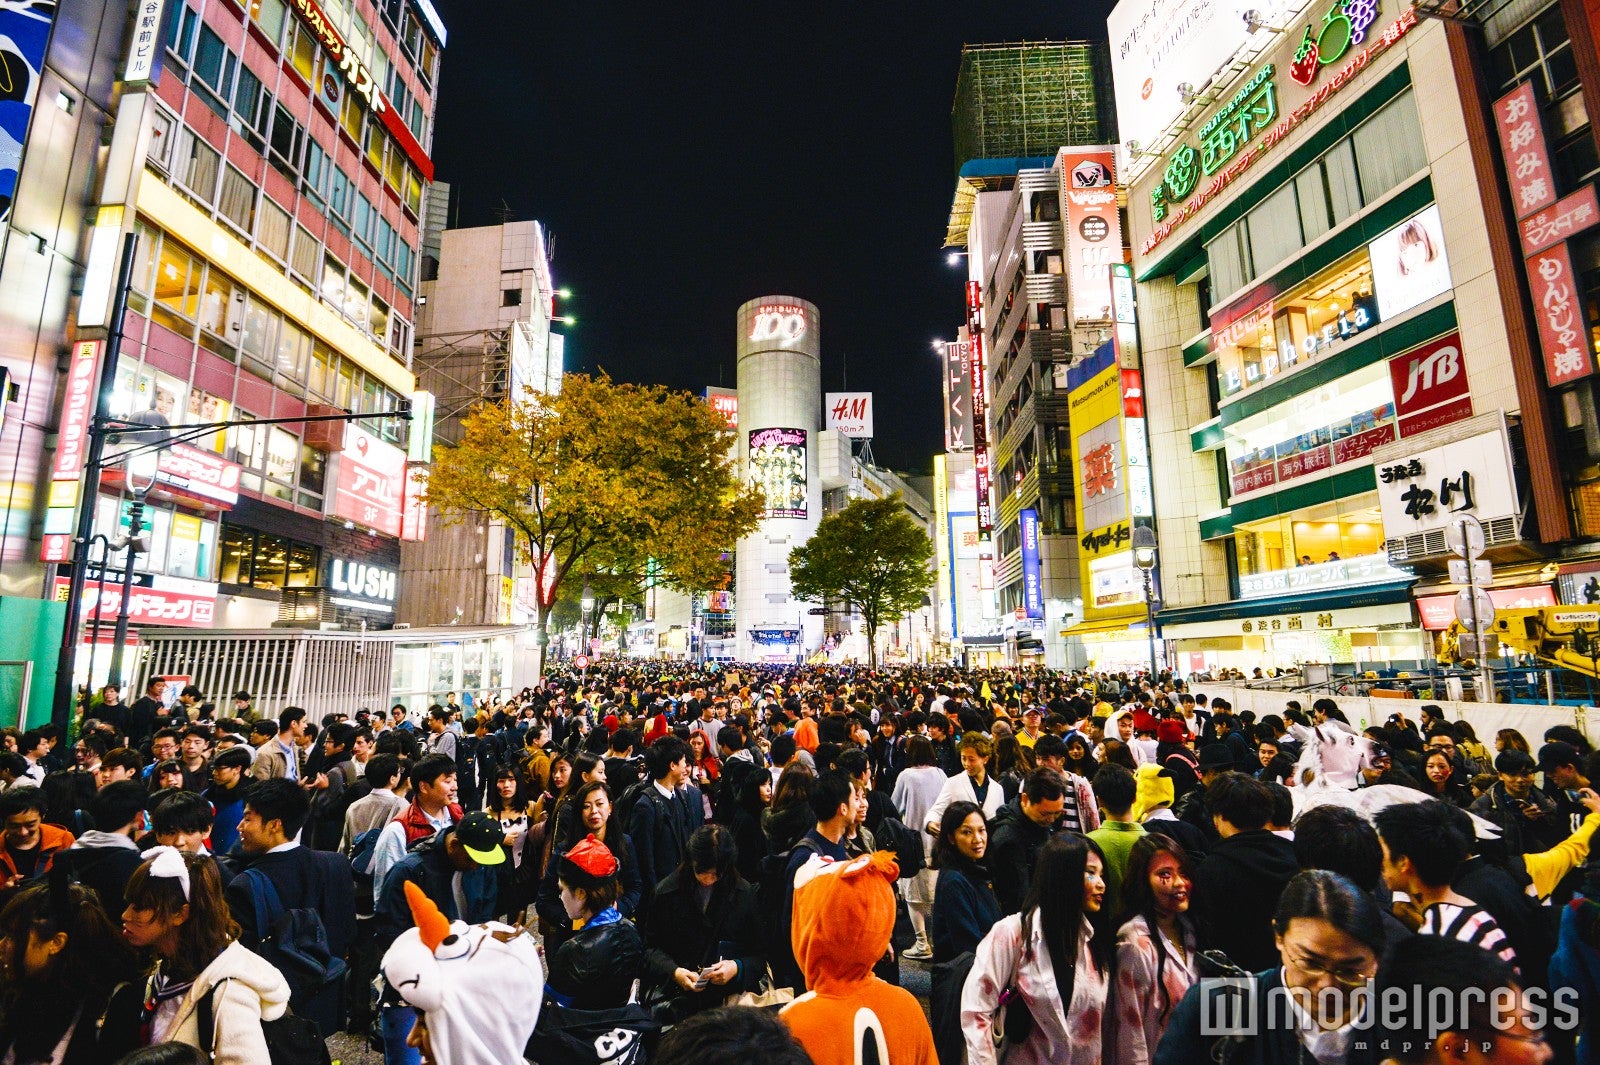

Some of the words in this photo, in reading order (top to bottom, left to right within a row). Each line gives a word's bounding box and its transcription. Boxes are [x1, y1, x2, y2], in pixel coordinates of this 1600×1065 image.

[133, 2, 158, 72] 谷駅前ビル
[340, 47, 386, 112] ガスト
[1198, 107, 1227, 138] FRUITS
[1235, 63, 1272, 102] PARLOR
[1201, 81, 1275, 177] 西村
[1505, 95, 1548, 209] お好み焼
[1152, 184, 1166, 223] 渋谷
[1524, 213, 1547, 231] 渋谷
[760, 306, 804, 315] SHIBUYA
[1538, 257, 1583, 377] もんじゃ焼
[749, 312, 806, 348] 109
[960, 344, 968, 375] TOKYO
[1226, 307, 1370, 391] Euphoria
[1401, 345, 1460, 405] JTB
[832, 398, 866, 420] H&M
[1071, 385, 1104, 409] Matsumoto
[61, 379, 88, 472] サンドラッグ
[836, 425, 857, 433] 50m
[1340, 428, 1388, 450] ハネムーン
[1235, 469, 1273, 490] 国内旅行
[1282, 451, 1326, 477] 海外旅行
[352, 466, 395, 502] アコム
[1401, 471, 1475, 520] 松川
[365, 505, 378, 523] 3F
[963, 532, 978, 547] 薬
[1026, 517, 1036, 550] MIZUHO
[332, 559, 396, 601] LUSH
